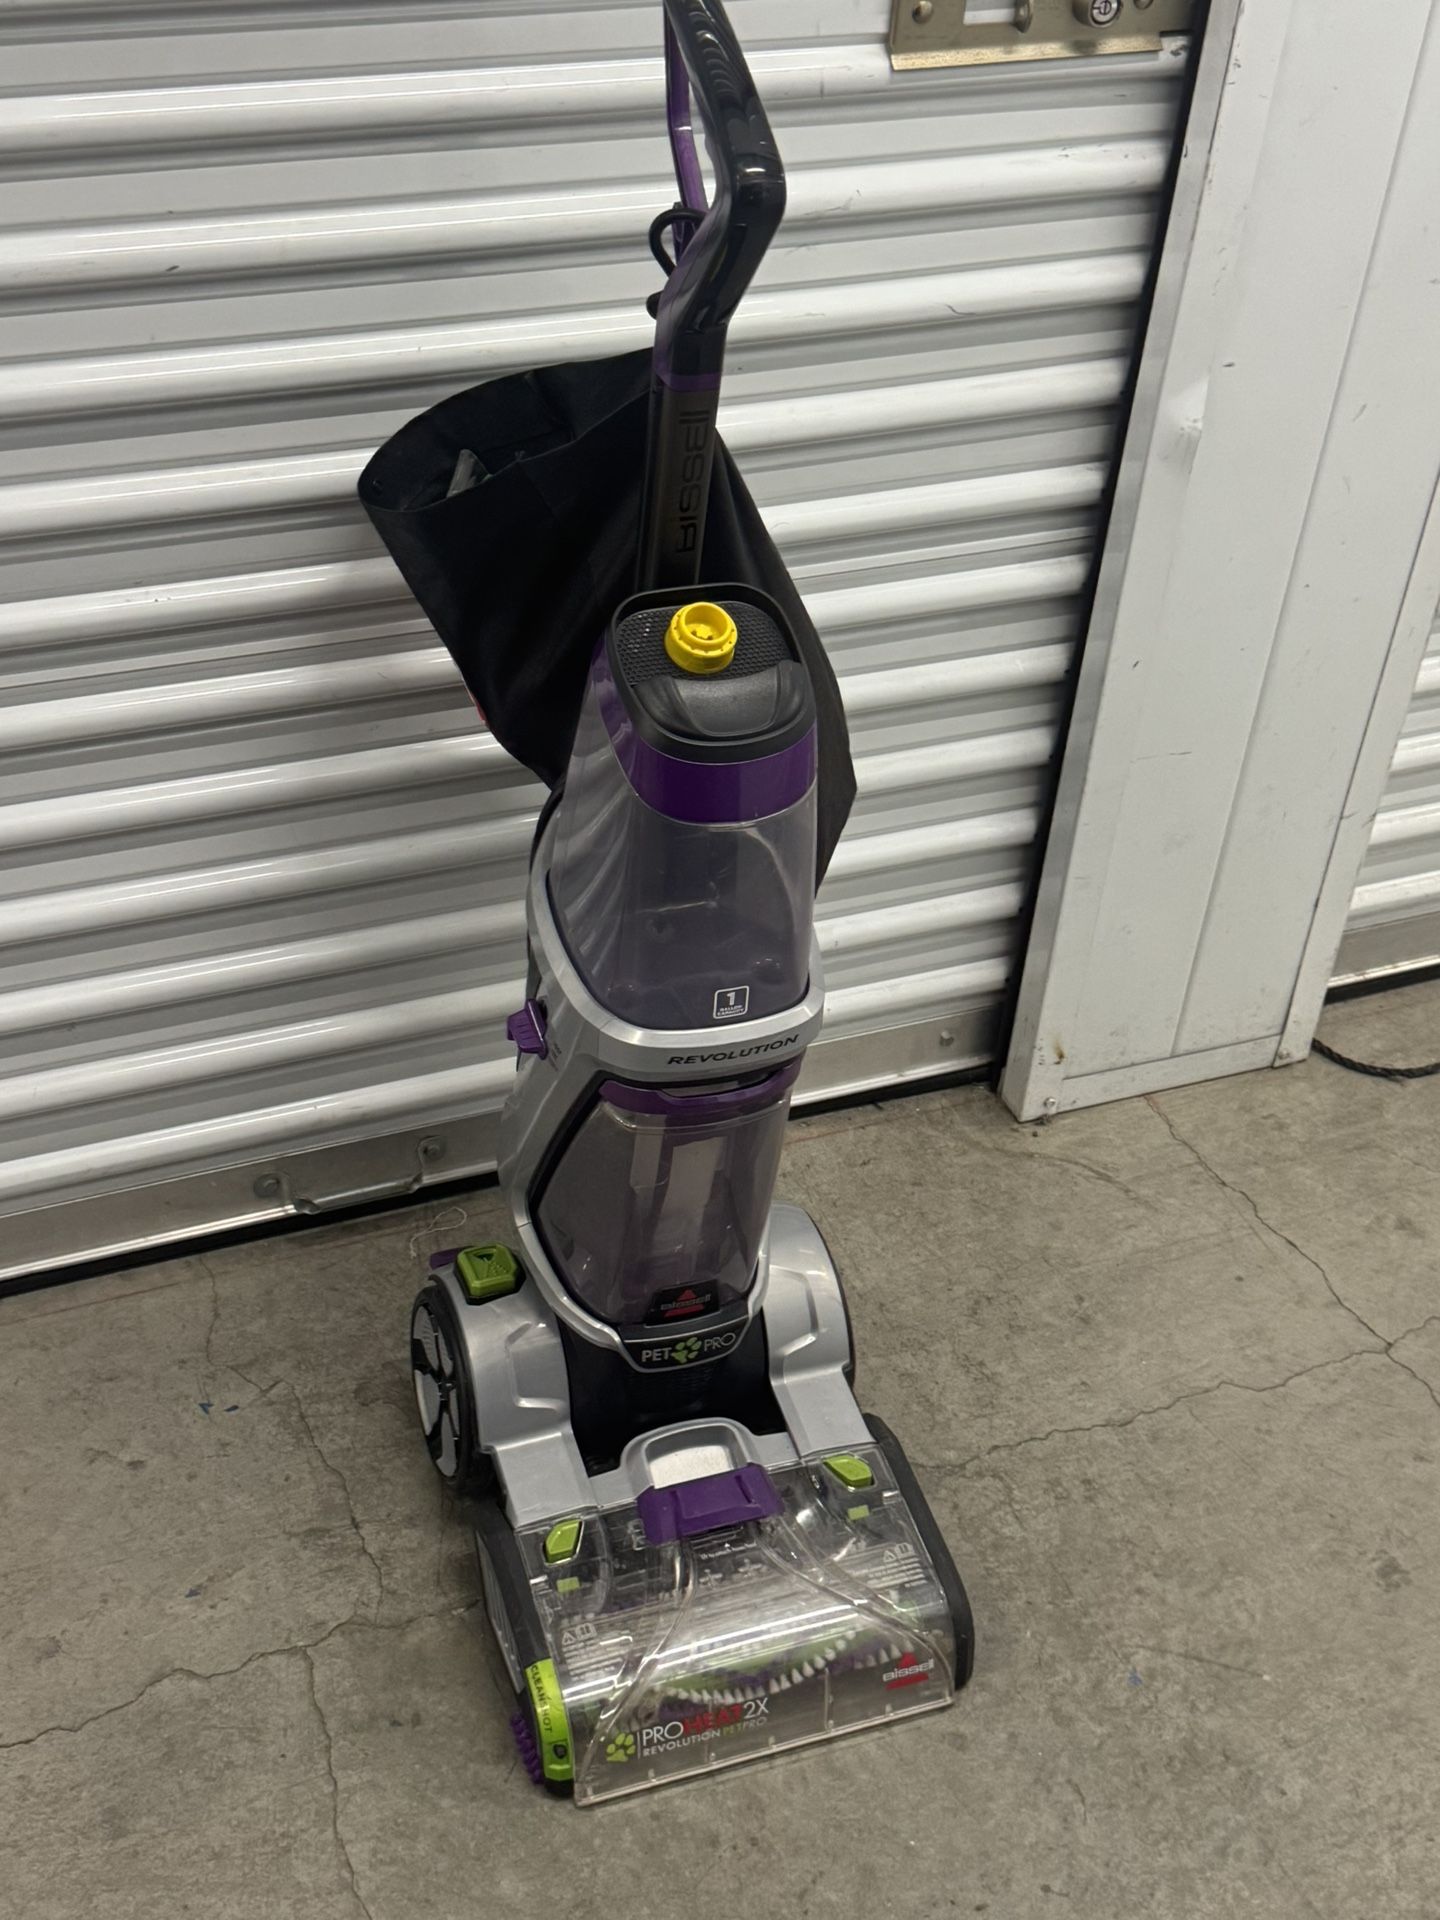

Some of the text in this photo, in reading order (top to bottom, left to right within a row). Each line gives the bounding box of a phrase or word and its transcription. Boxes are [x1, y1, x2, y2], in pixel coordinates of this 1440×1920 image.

[726, 991, 736, 1006] 1
[667, 1034, 799, 1065] REVOLUTION
[641, 1332, 736, 1362] PET PRO
